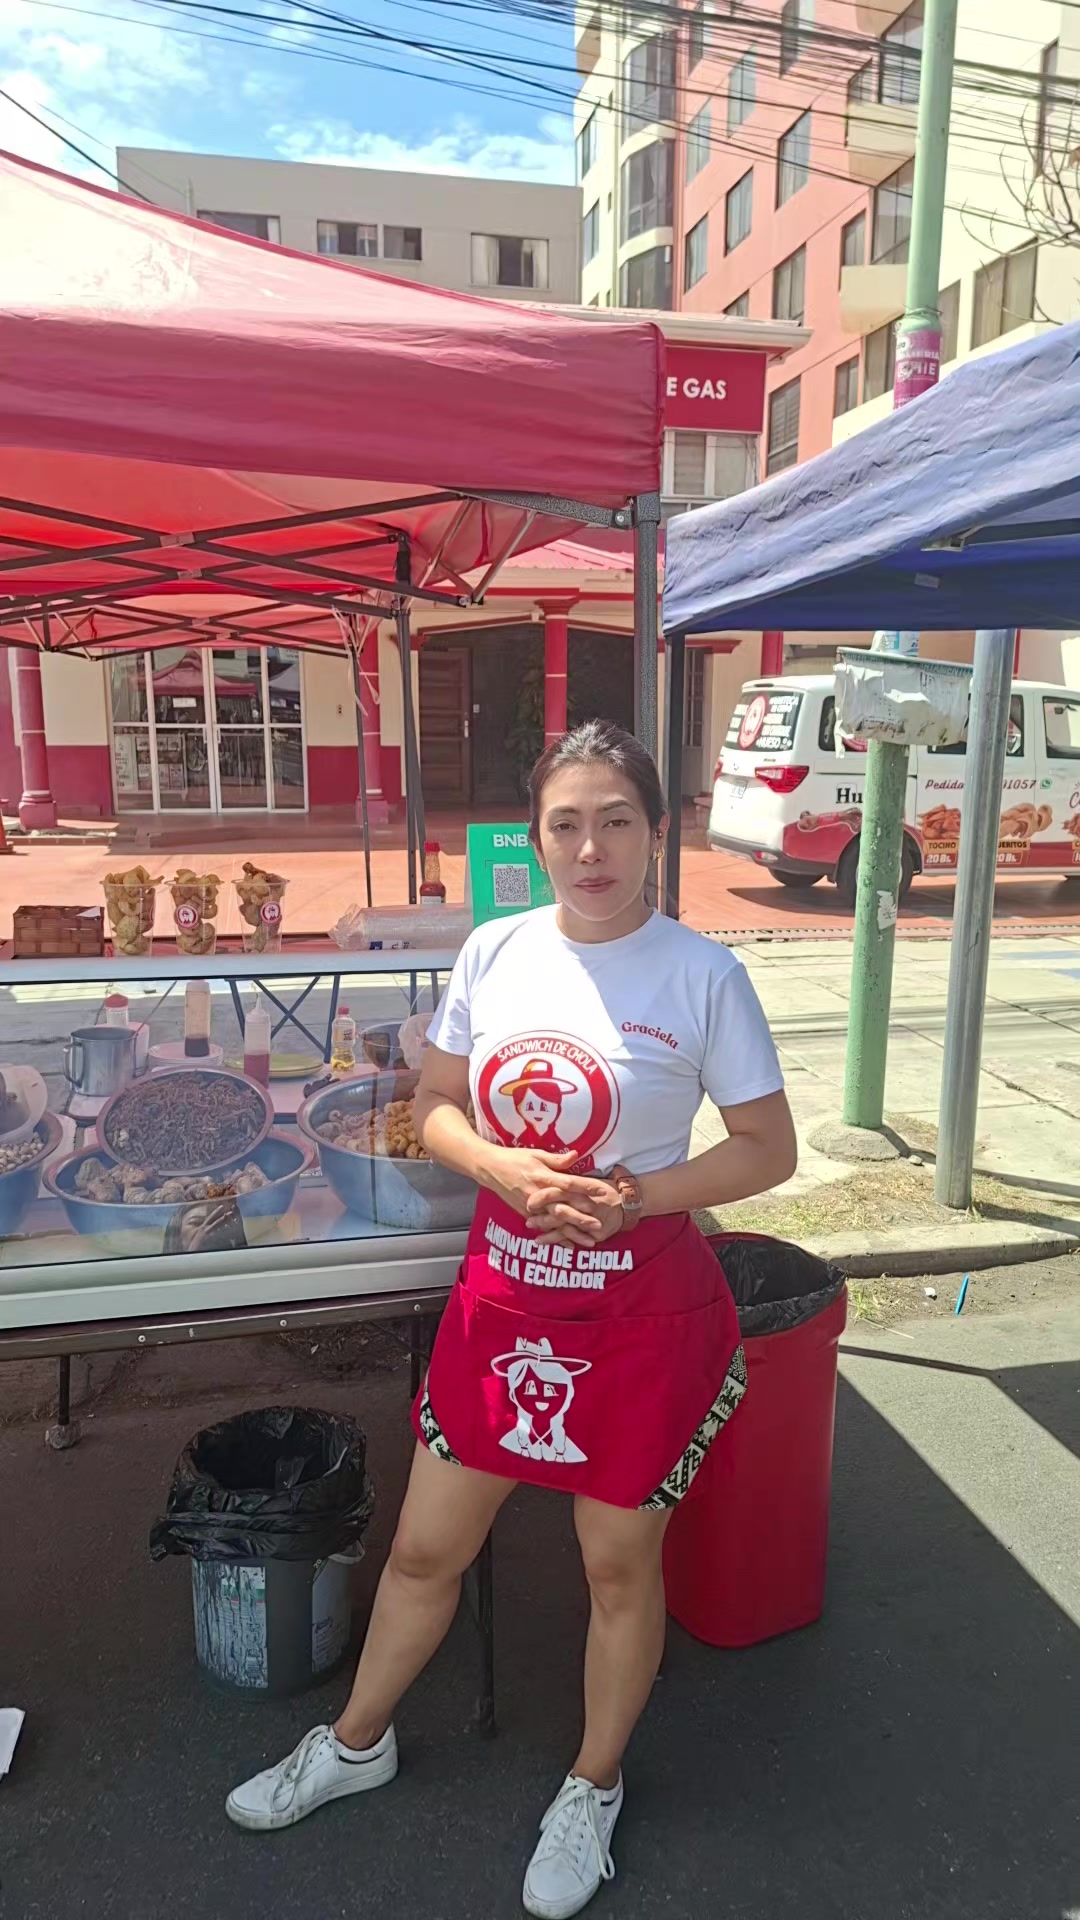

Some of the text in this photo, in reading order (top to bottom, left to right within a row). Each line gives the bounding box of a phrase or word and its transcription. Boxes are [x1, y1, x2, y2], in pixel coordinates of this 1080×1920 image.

[682, 377, 727, 400] GAS
[835, 787, 863, 804] Hu
[493, 833, 529, 848] BNB
[926, 853, 940, 864] 20
[621, 1021, 679, 1050] Graciela
[497, 1039, 598, 1075] SANDWICH DE CHOLA
[487, 1245, 606, 1290] DE LA ECUADOR
[551, 1244, 574, 1269] DE
[576, 1249, 634, 1271] CHOLA
